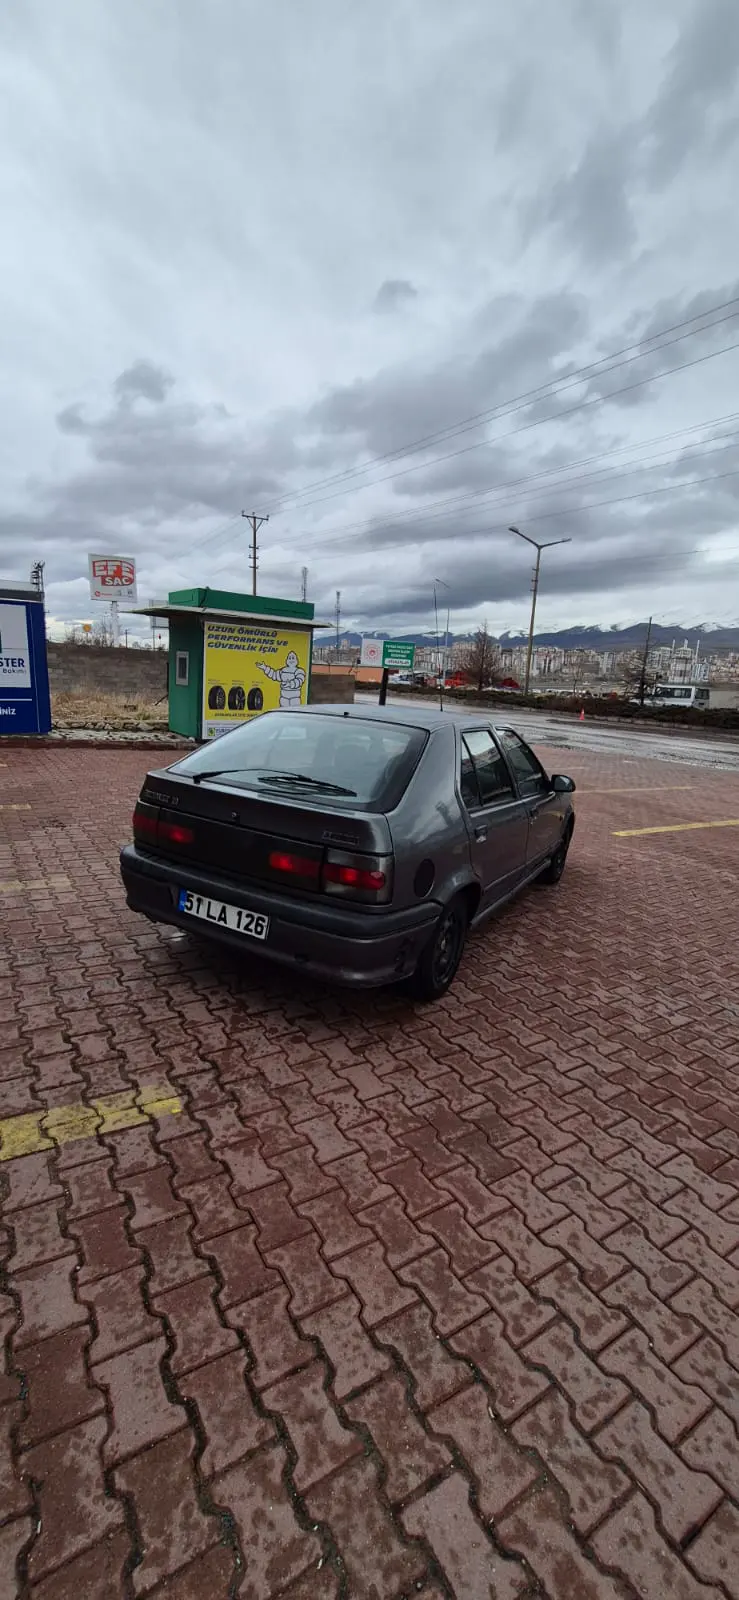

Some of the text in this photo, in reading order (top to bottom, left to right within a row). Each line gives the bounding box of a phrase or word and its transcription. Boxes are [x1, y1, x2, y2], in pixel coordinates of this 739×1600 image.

[92, 560, 134, 577] EFE
[207, 624, 278, 638] UZUN ÖMÜRLÜ
[207, 633, 275, 645] PERFORMANS
[207, 641, 279, 654] GÜVENLİK İÇİN
[185, 893, 266, 936] 51 LA 126
